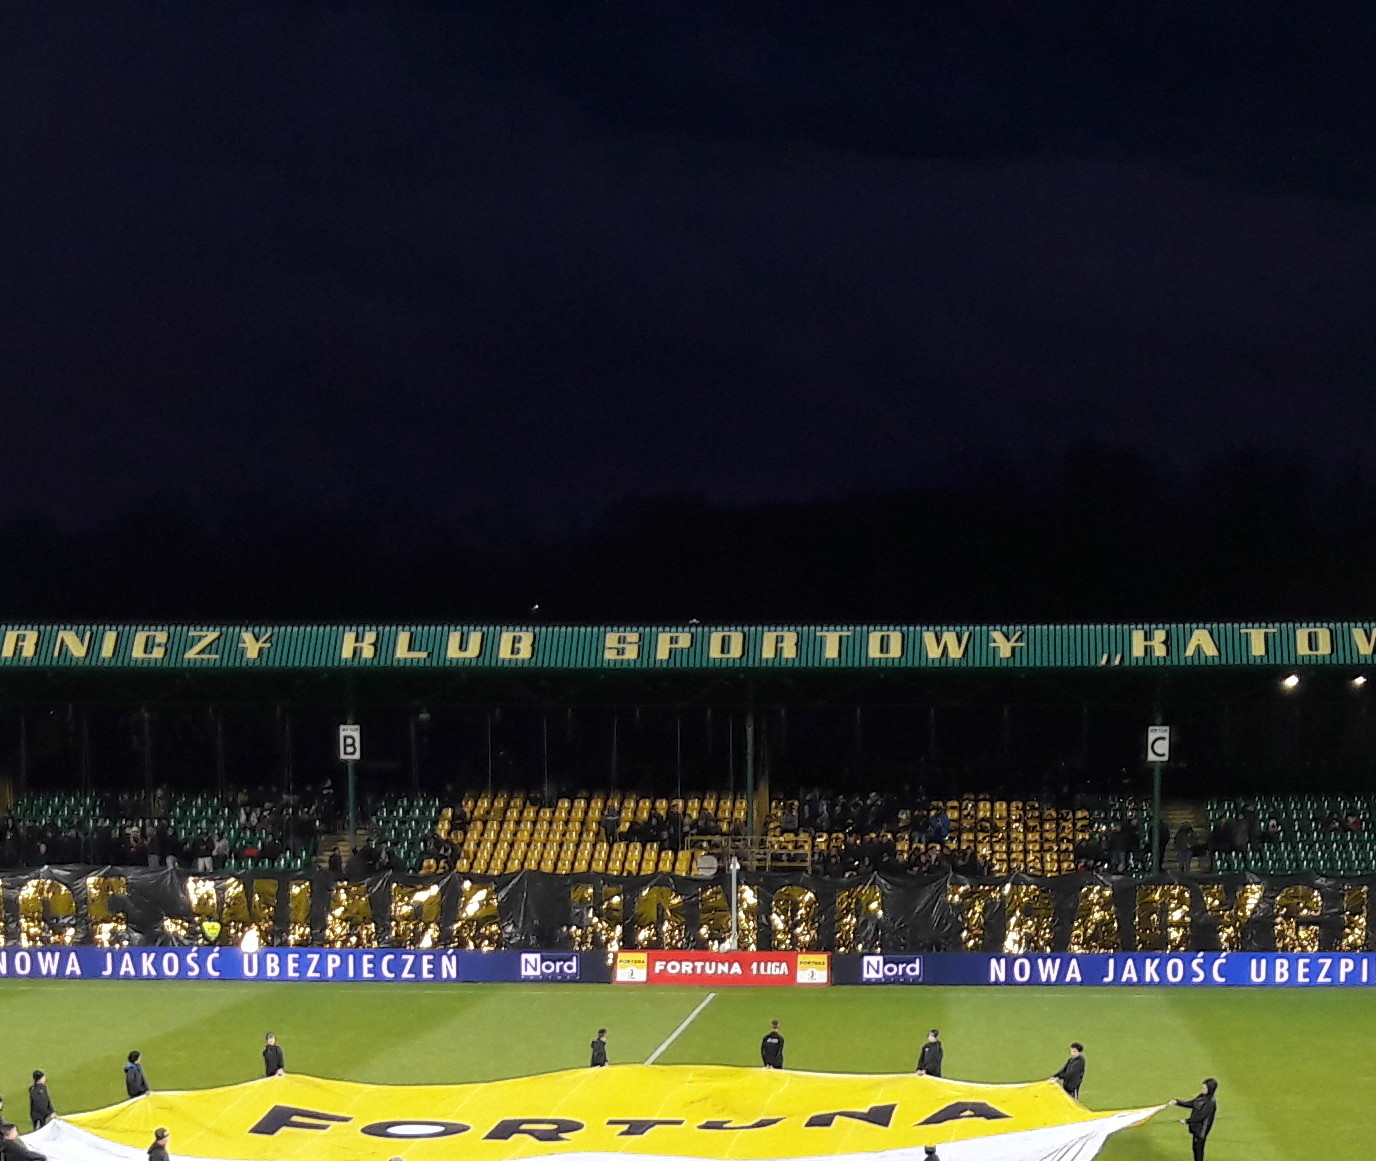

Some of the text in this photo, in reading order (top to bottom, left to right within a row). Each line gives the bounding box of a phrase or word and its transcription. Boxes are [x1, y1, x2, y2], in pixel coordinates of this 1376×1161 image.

[341, 630, 534, 659] KLUB
[603, 630, 1026, 660] SPORTOWY
[343, 735, 357, 756] B
[1150, 736, 1167, 757] C
[101, 945, 221, 977] JAKOŚĆ
[242, 950, 457, 979] UBEZPIECZEŃ
[520, 953, 577, 977] Nord
[654, 960, 743, 976] FORTUNA
[862, 955, 920, 979] Nord
[990, 957, 1082, 983] NOWA
[1102, 951, 1230, 983] JAKOŚĆ
[248, 1100, 1012, 1142] FORTUNA
